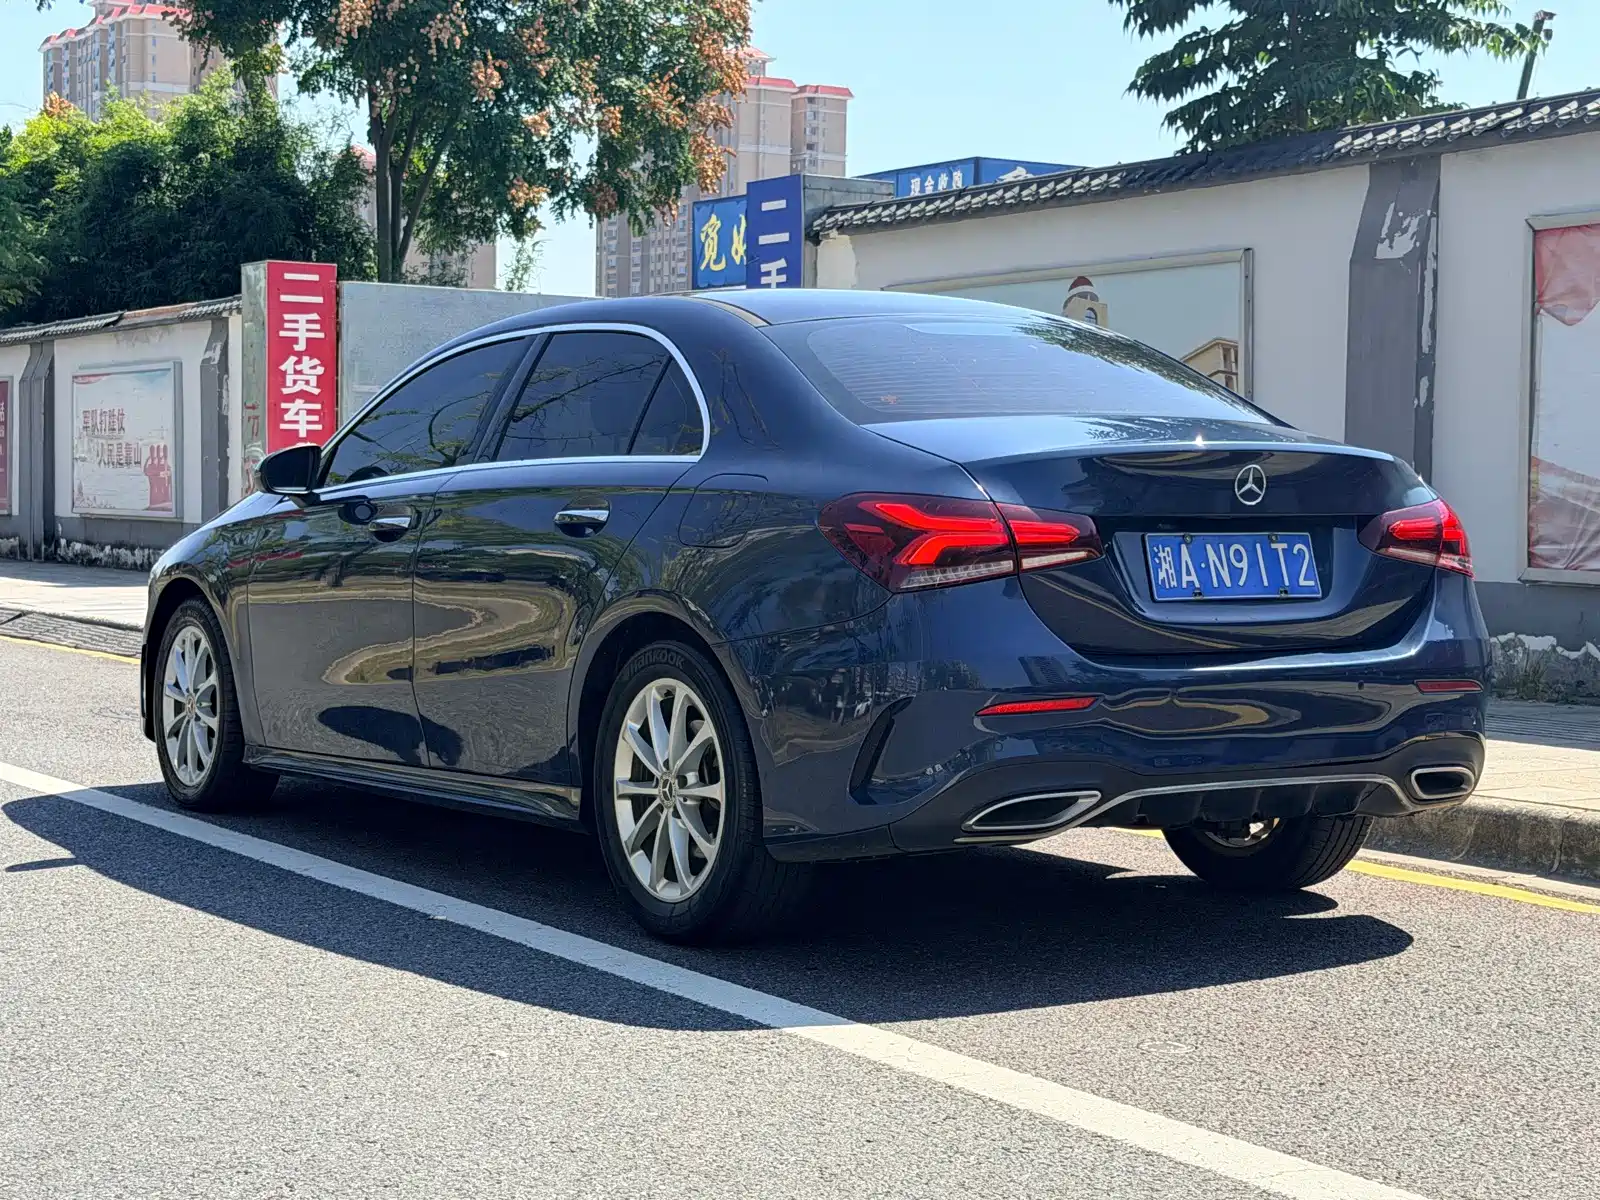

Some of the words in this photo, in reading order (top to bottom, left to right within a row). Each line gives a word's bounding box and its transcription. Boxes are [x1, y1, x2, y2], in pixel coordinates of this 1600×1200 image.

[758, 199, 788, 288] 二手
[279, 272, 325, 438] 二手货车
[1153, 543, 1316, 589] 湘A·N91T2
